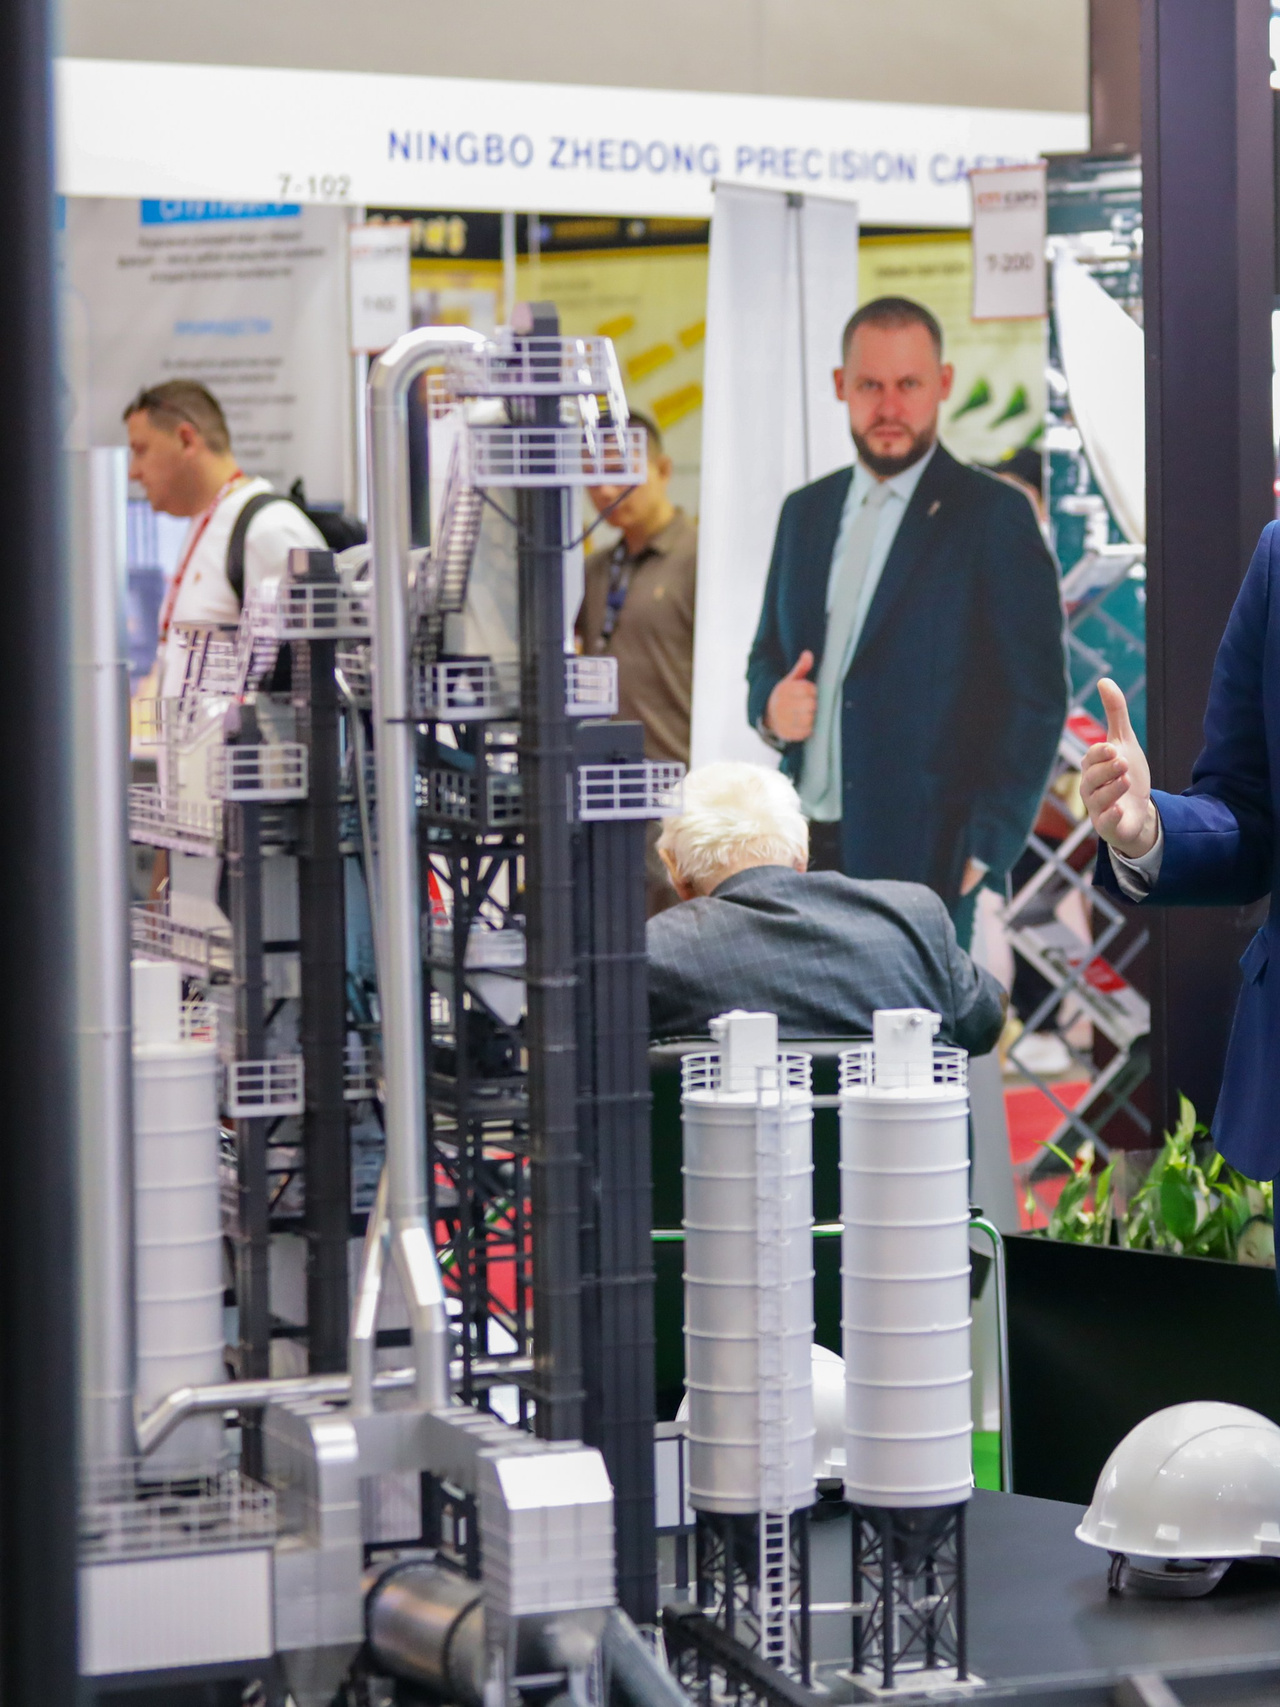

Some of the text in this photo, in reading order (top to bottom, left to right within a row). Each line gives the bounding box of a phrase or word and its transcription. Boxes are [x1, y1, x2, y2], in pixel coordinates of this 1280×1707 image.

[387, 130, 534, 169] NINGBO
[548, 136, 720, 175] ZHEDONG
[279, 172, 351, 199] 7-102
